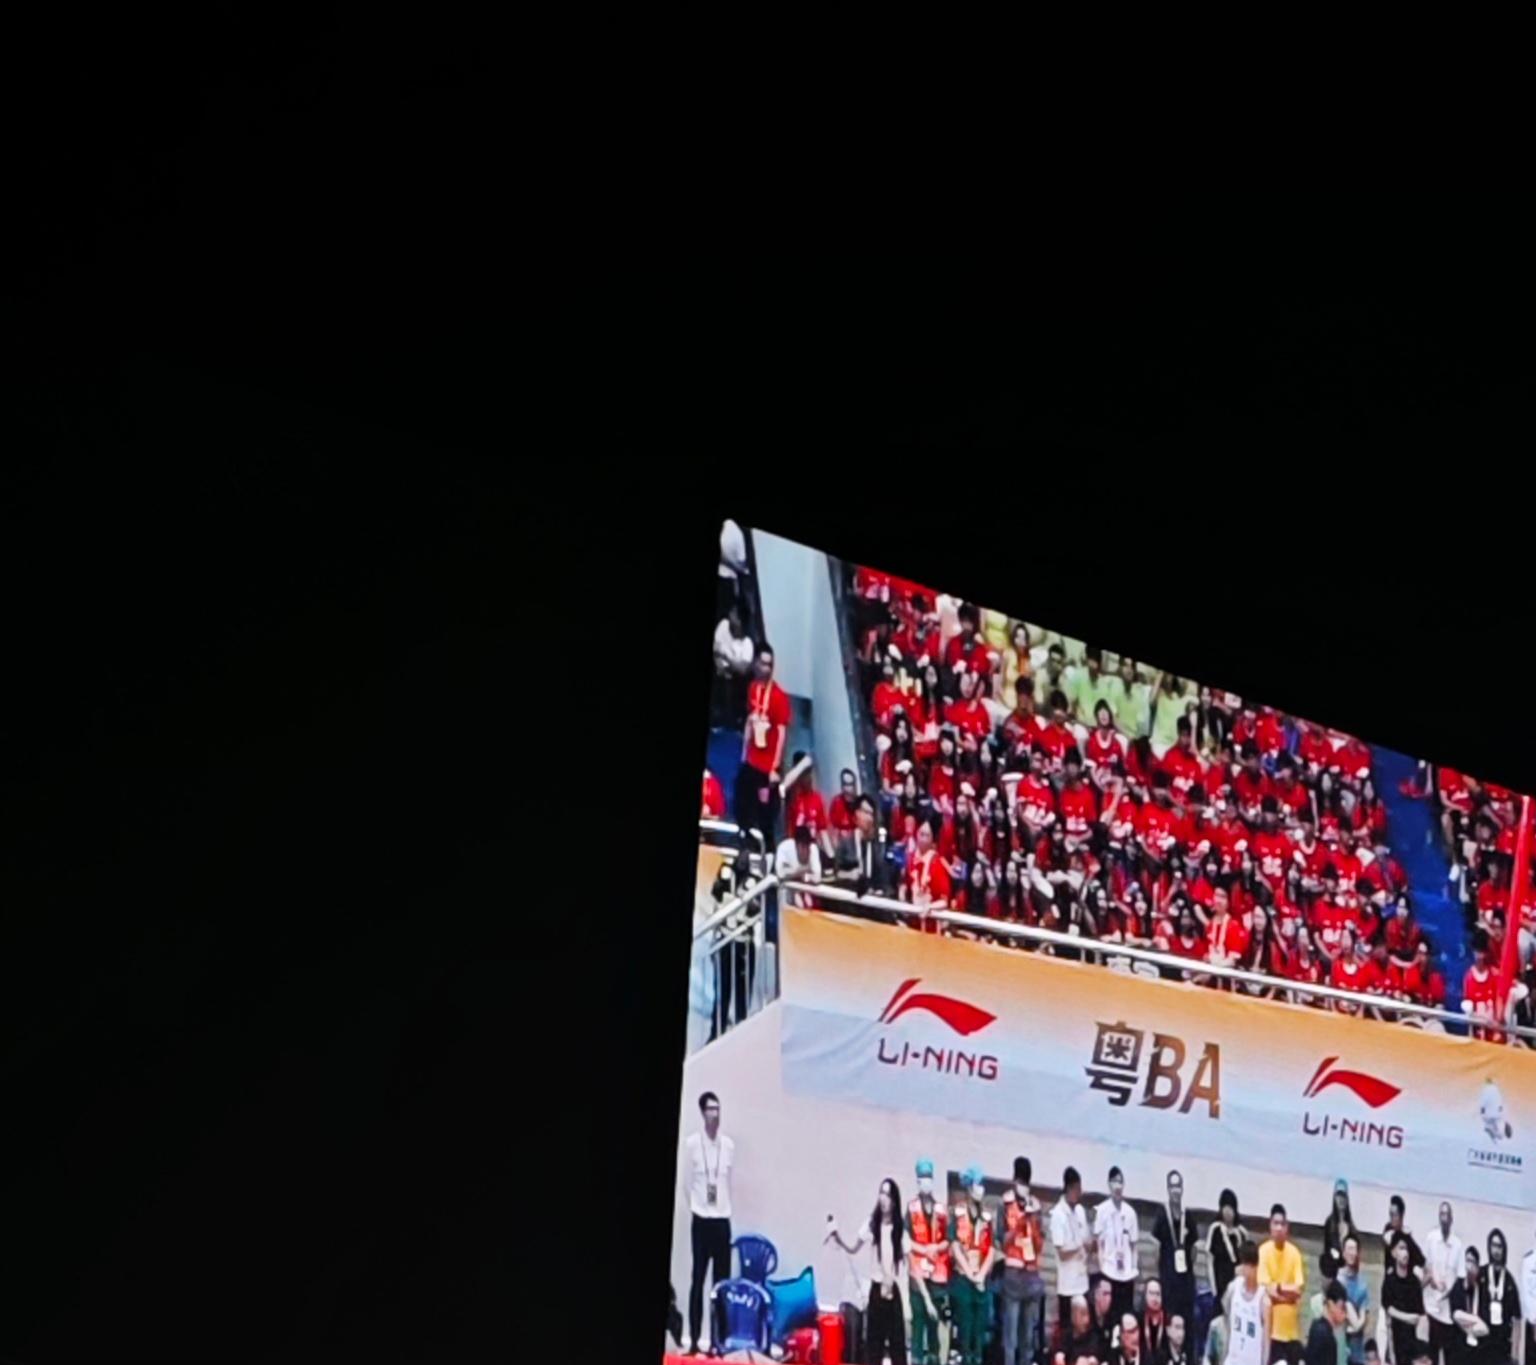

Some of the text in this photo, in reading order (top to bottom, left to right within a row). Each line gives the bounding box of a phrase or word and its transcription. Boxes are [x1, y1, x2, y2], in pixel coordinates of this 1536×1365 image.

[877, 1037, 998, 1081] LI-NING
[1084, 1020, 1222, 1120] 粤BA
[1303, 1112, 1404, 1149] LI-NING
